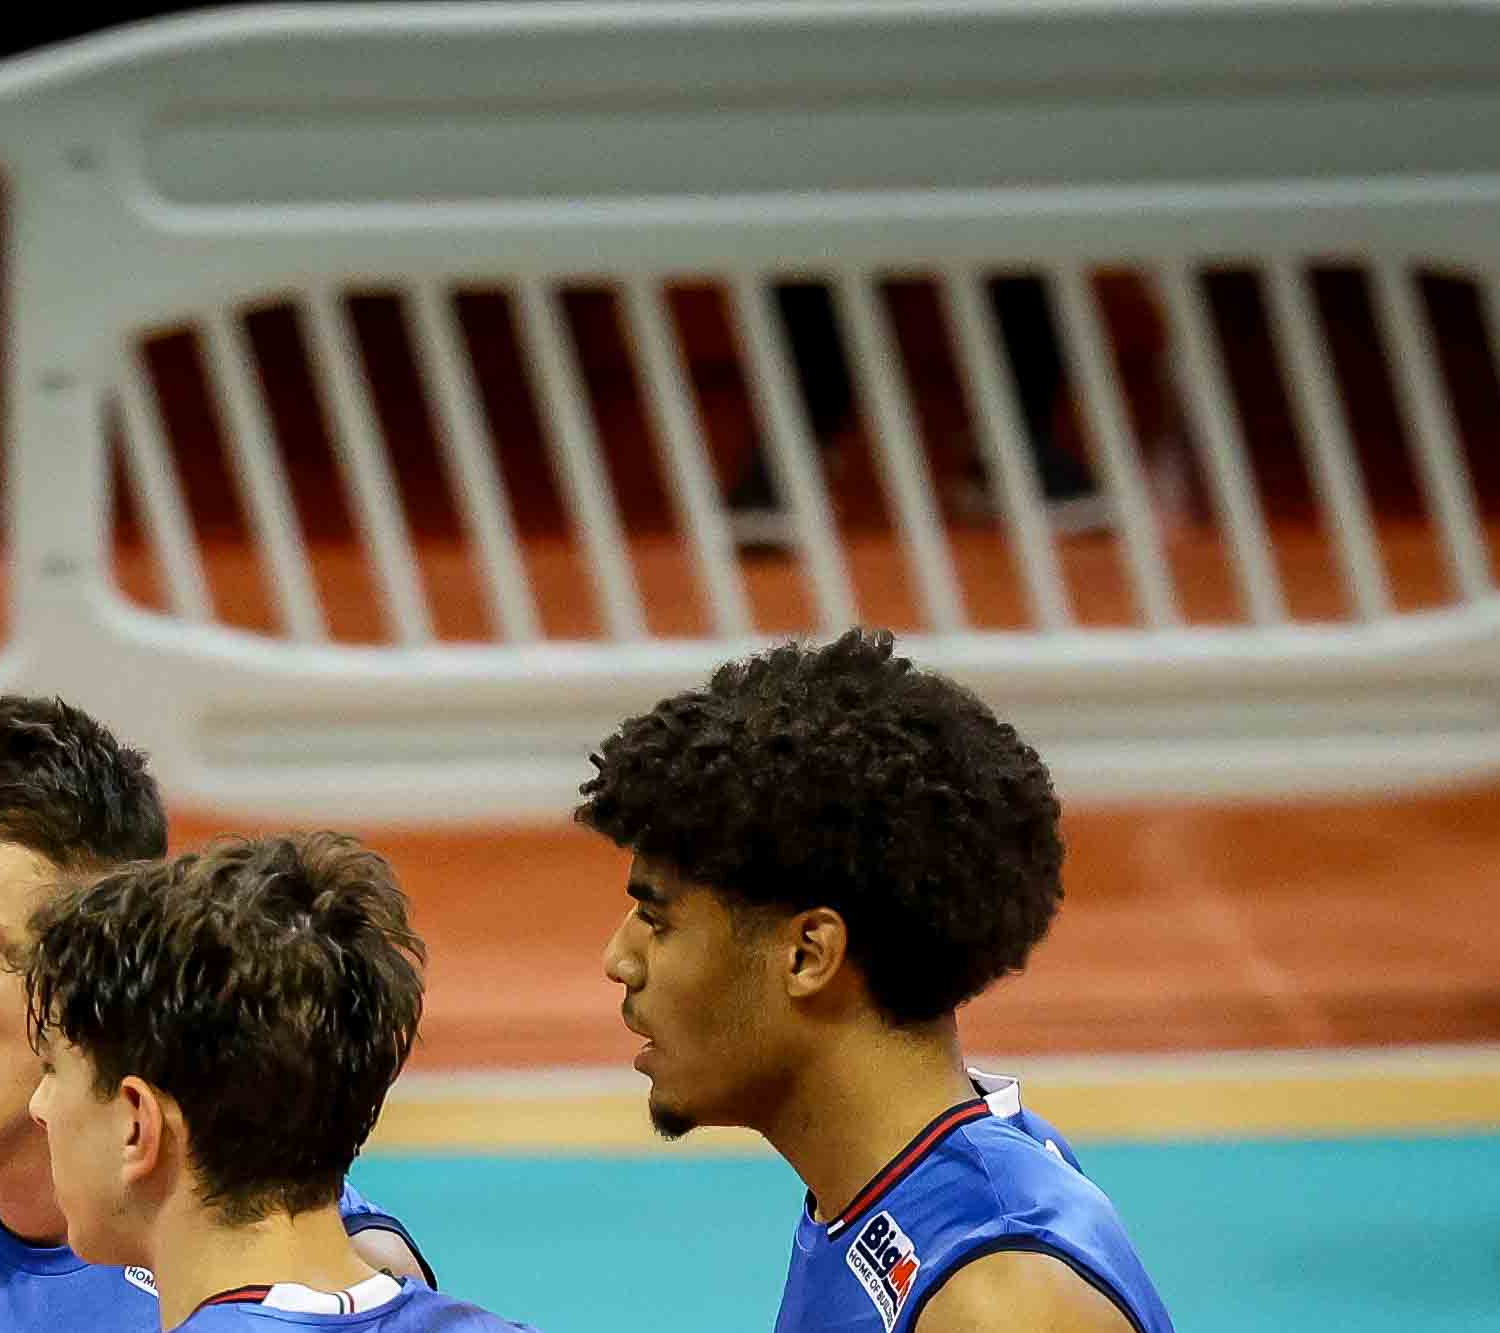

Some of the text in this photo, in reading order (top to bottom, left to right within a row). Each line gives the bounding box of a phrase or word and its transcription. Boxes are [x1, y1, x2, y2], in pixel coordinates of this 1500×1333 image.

[128, 1266, 157, 1290] HOM
[849, 1250, 873, 1282] HOME
[869, 1279, 881, 1293] OF
